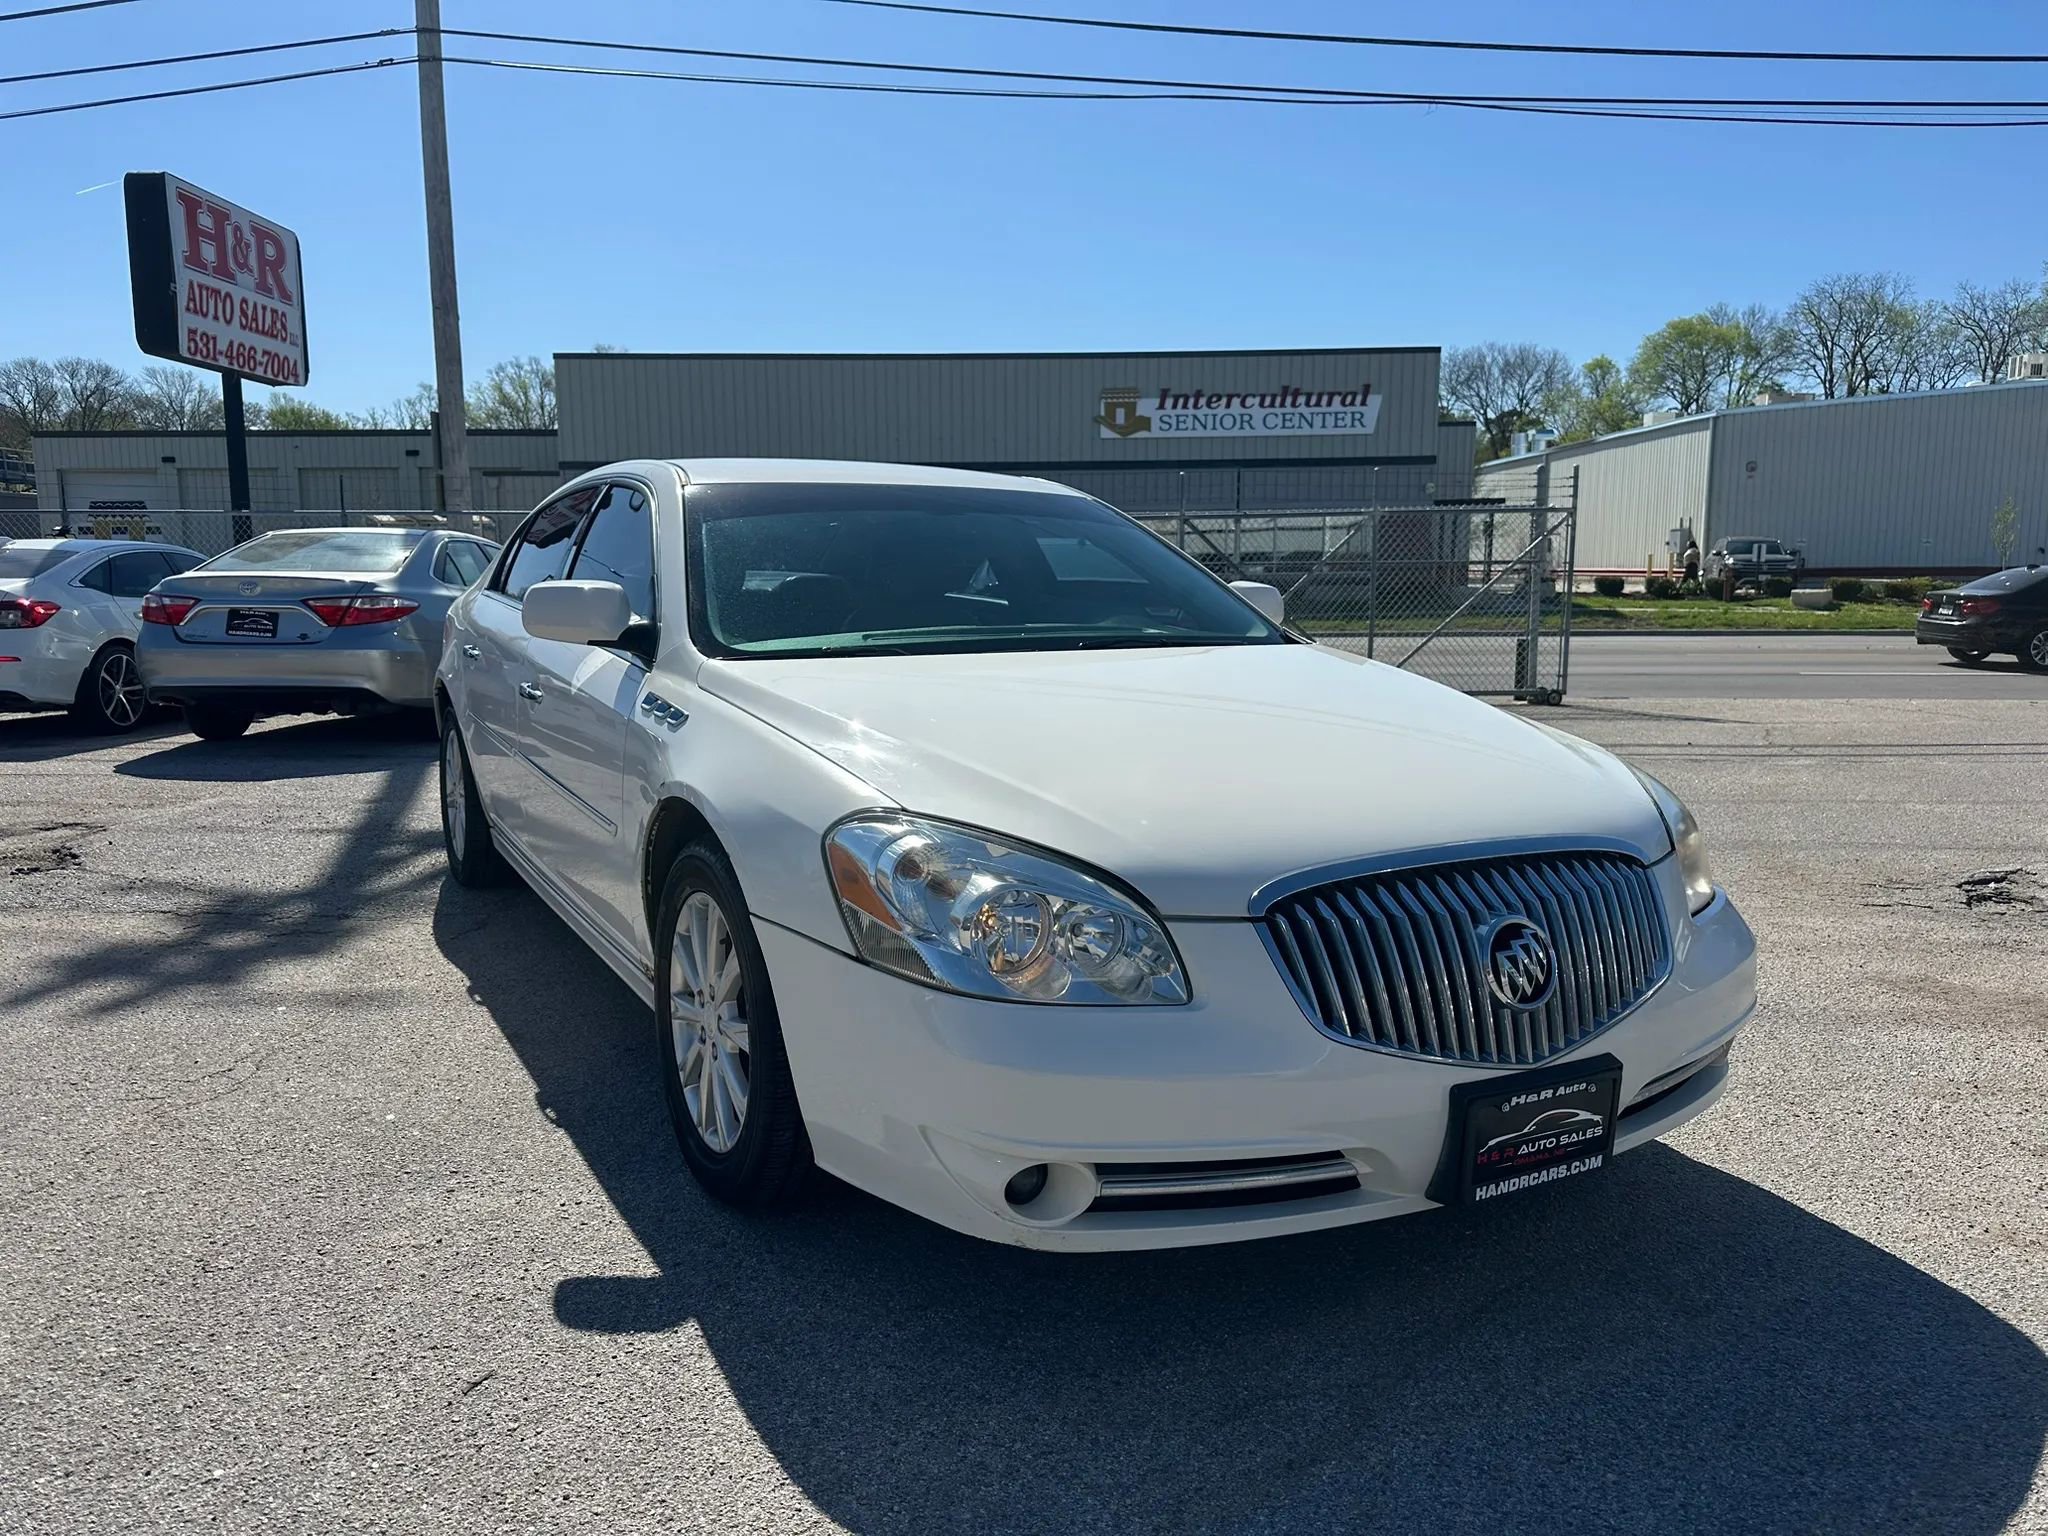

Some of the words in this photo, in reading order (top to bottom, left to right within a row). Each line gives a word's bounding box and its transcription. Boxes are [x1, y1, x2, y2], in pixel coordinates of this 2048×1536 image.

[176, 187, 293, 305] H&R
[185, 279, 235, 326] AUTO
[239, 296, 288, 343] SALES
[187, 327, 300, 383] 531-466-7004
[1155, 384, 1372, 411] Intercultural
[1158, 412, 1255, 432] SENIOR
[1262, 411, 1366, 430] CENTER
[1511, 1089, 1554, 1106] H&R
[1556, 1082, 1587, 1096] Auto
[1517, 1137, 1557, 1155] AUTO
[1559, 1126, 1603, 1145] SALES
